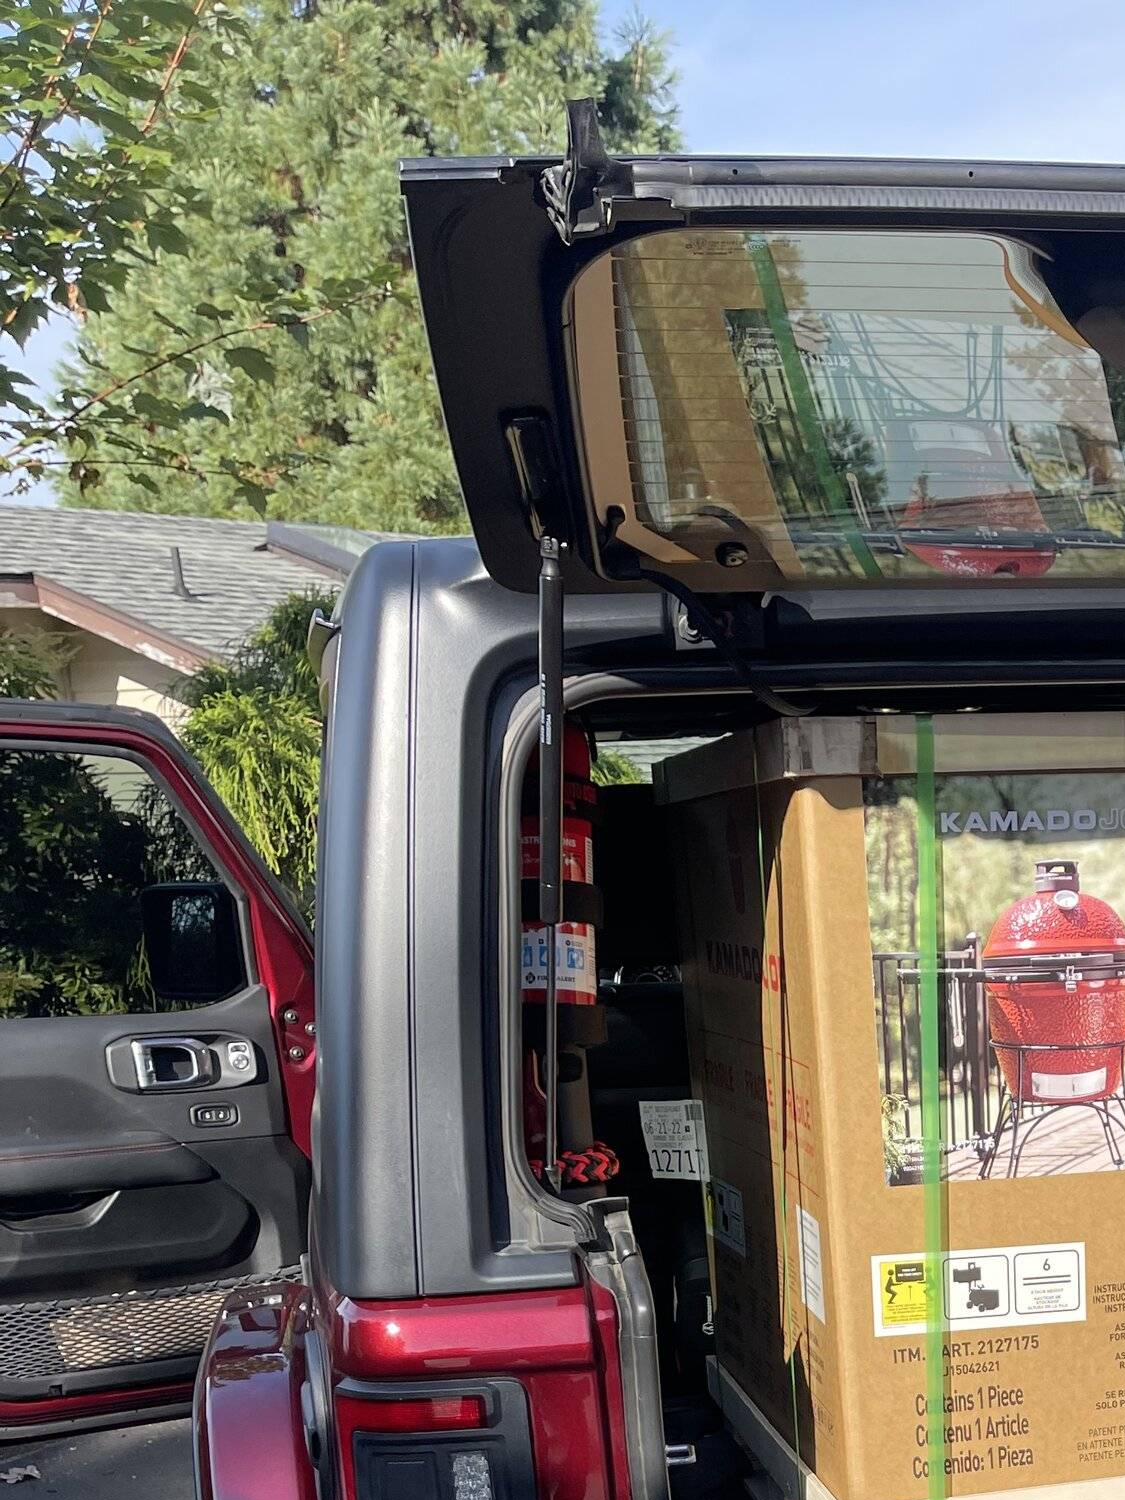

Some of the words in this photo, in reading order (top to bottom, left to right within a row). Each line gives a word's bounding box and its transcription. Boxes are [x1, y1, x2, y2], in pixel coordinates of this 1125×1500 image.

[1043, 1259, 1050, 1271] 6
[1109, 1332, 1125, 1342] FOR
[893, 1347, 926, 1364] ITM.
[942, 1342, 975, 1358] ART.
[977, 1335, 1039, 1355] 2127175
[915, 1390, 974, 1416] Ctains
[977, 1387, 984, 1409] 1
[988, 1385, 1024, 1408] Piece
[1105, 1391, 1117, 1399] SE
[1095, 1401, 1118, 1410] SOLO
[916, 1424, 972, 1447] Ctenu
[975, 1417, 981, 1440] 1
[985, 1413, 1029, 1439] Article
[1088, 1426, 1118, 1438] PATENT
[1077, 1441, 1088, 1451] EN
[1089, 1436, 1124, 1449] ATTENTE
[1079, 1449, 1113, 1462] PATENTE
[913, 1450, 984, 1479] Coenido:
[988, 1447, 994, 1469] 1
[998, 1446, 1034, 1468] Pieza
